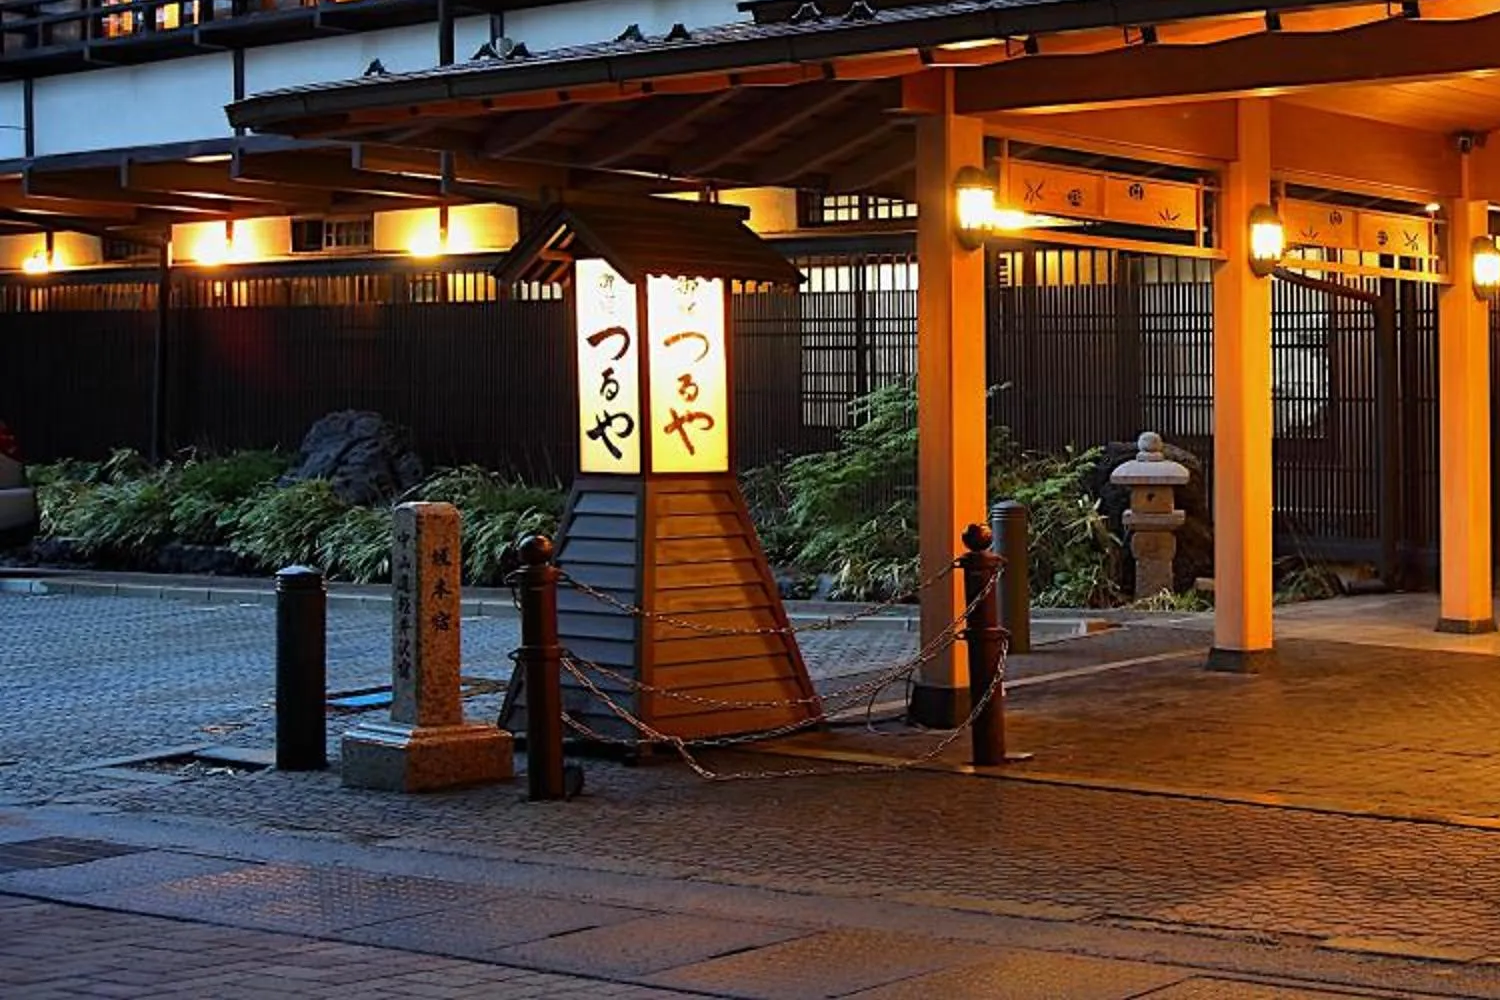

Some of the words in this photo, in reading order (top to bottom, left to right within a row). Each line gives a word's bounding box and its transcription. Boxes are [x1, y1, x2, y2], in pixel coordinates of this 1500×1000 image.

[586, 326, 634, 460] つるや
[664, 331, 714, 455] つるや
